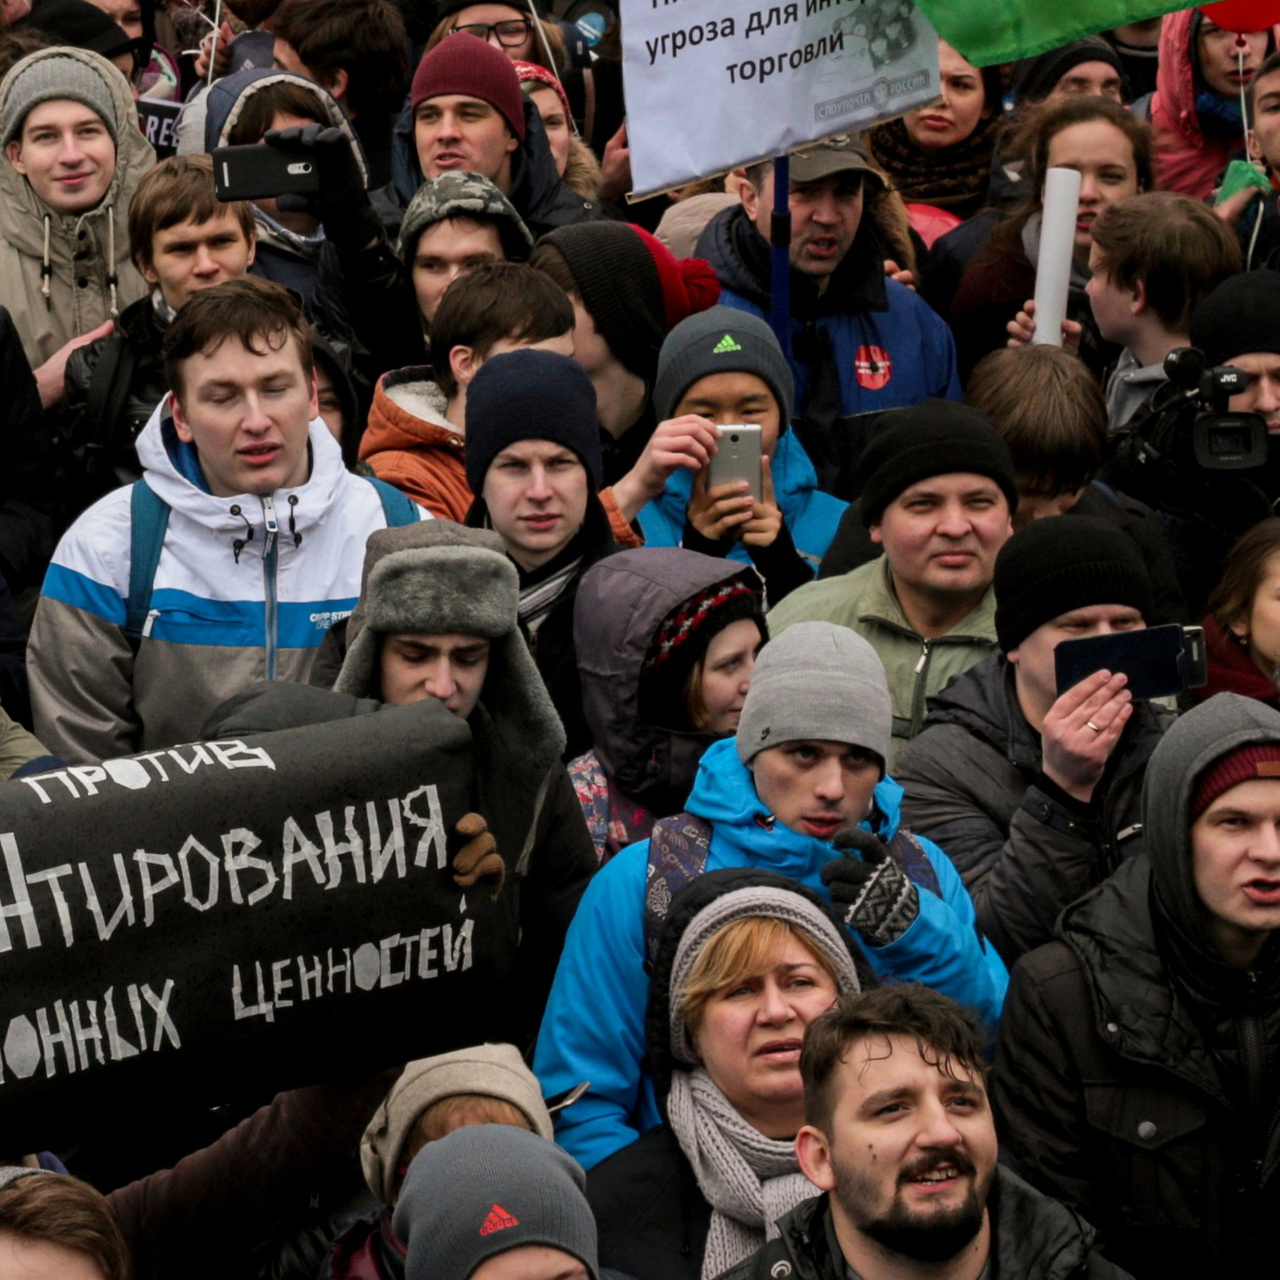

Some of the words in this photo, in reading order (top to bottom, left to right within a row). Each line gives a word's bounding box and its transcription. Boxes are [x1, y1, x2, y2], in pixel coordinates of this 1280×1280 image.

[645, 16, 736, 66] угроза
[745, 3, 798, 39] для
[726, 31, 844, 84] торговли
[1220, 373, 1238, 383] JVC
[20, 739, 276, 804] ПРОТИВ
[231, 893, 475, 1024] ЦЕННОСТЕЙ
